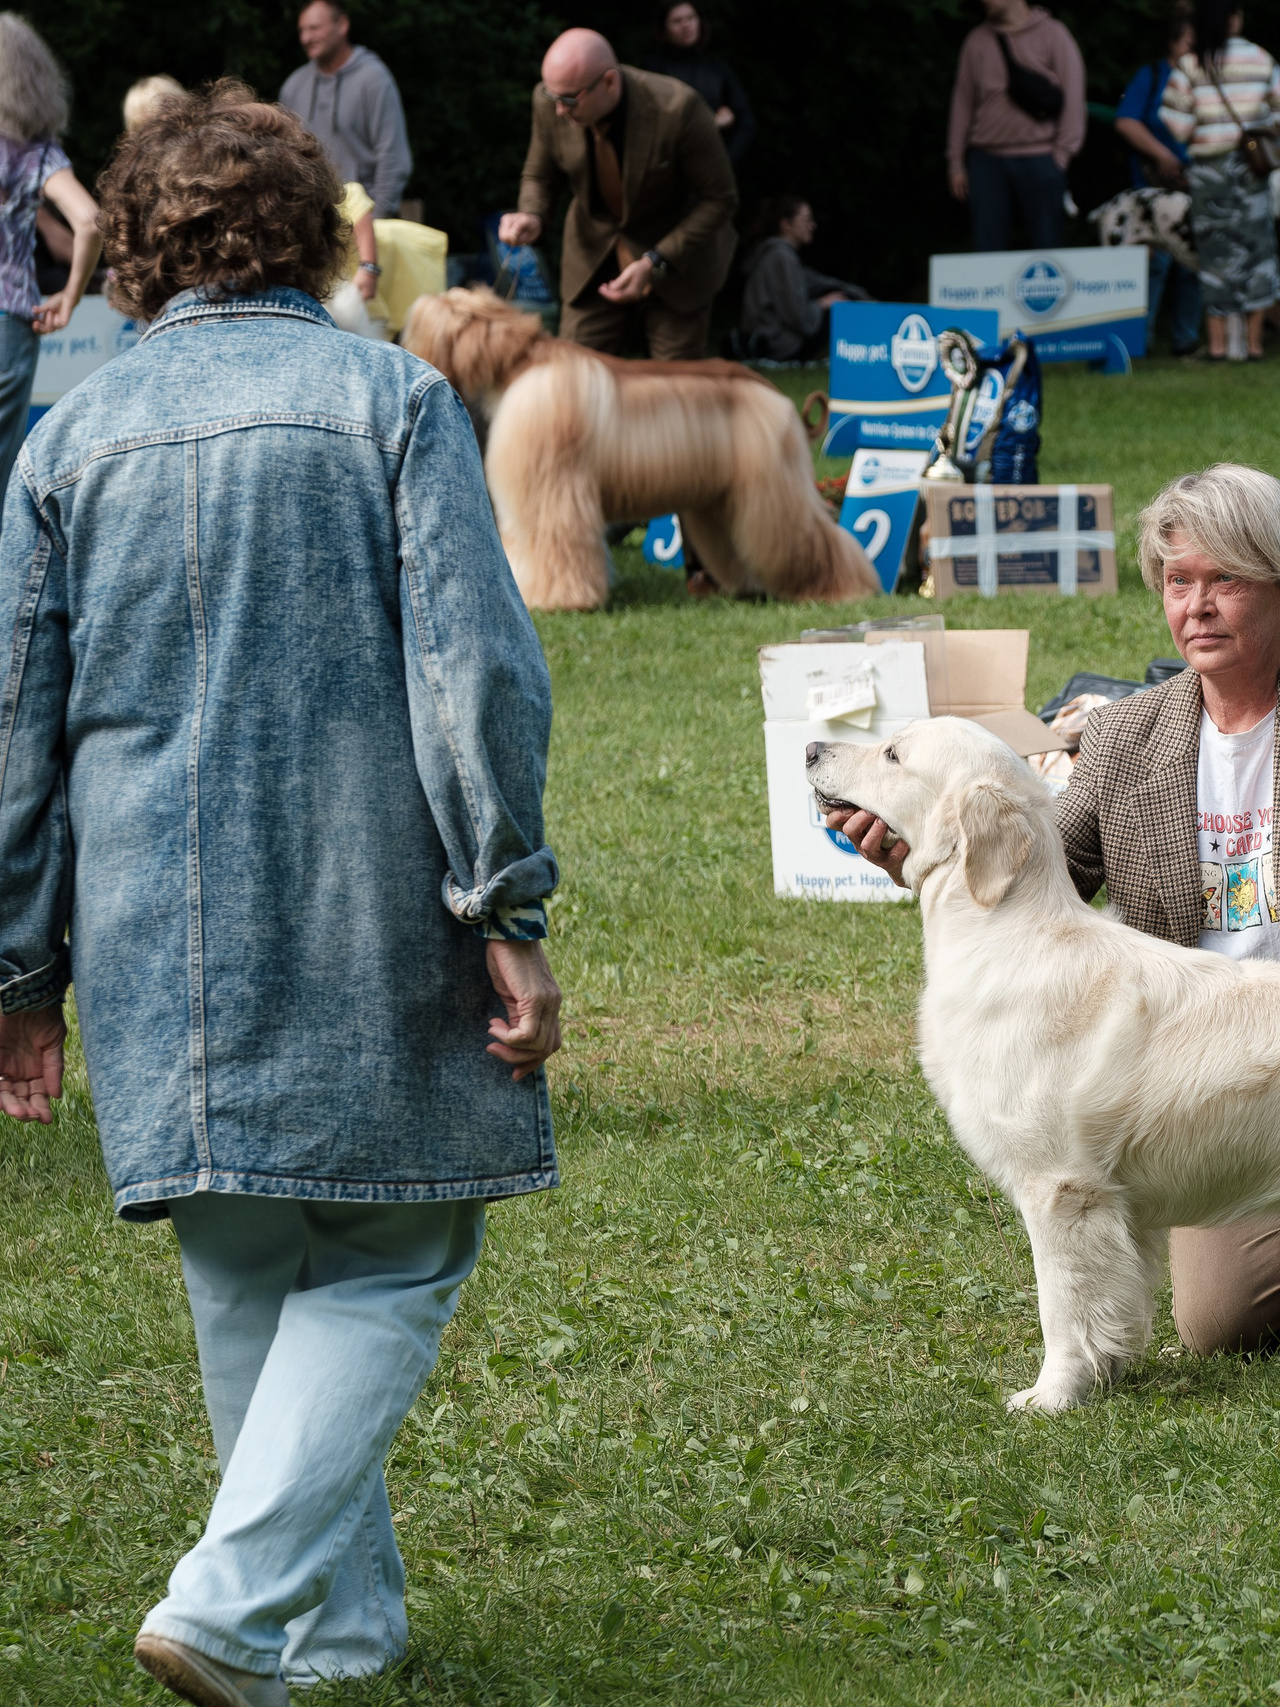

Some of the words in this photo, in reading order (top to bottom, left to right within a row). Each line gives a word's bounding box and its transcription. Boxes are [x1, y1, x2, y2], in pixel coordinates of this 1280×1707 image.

[836, 338, 867, 364] Happy
[853, 508, 892, 562] 2
[1196, 811, 1253, 834] CHOOSE
[1258, 806, 1274, 828] YO
[1226, 831, 1262, 857] CARD
[795, 872, 831, 889] Happy
[1200, 868, 1217, 877] ING
